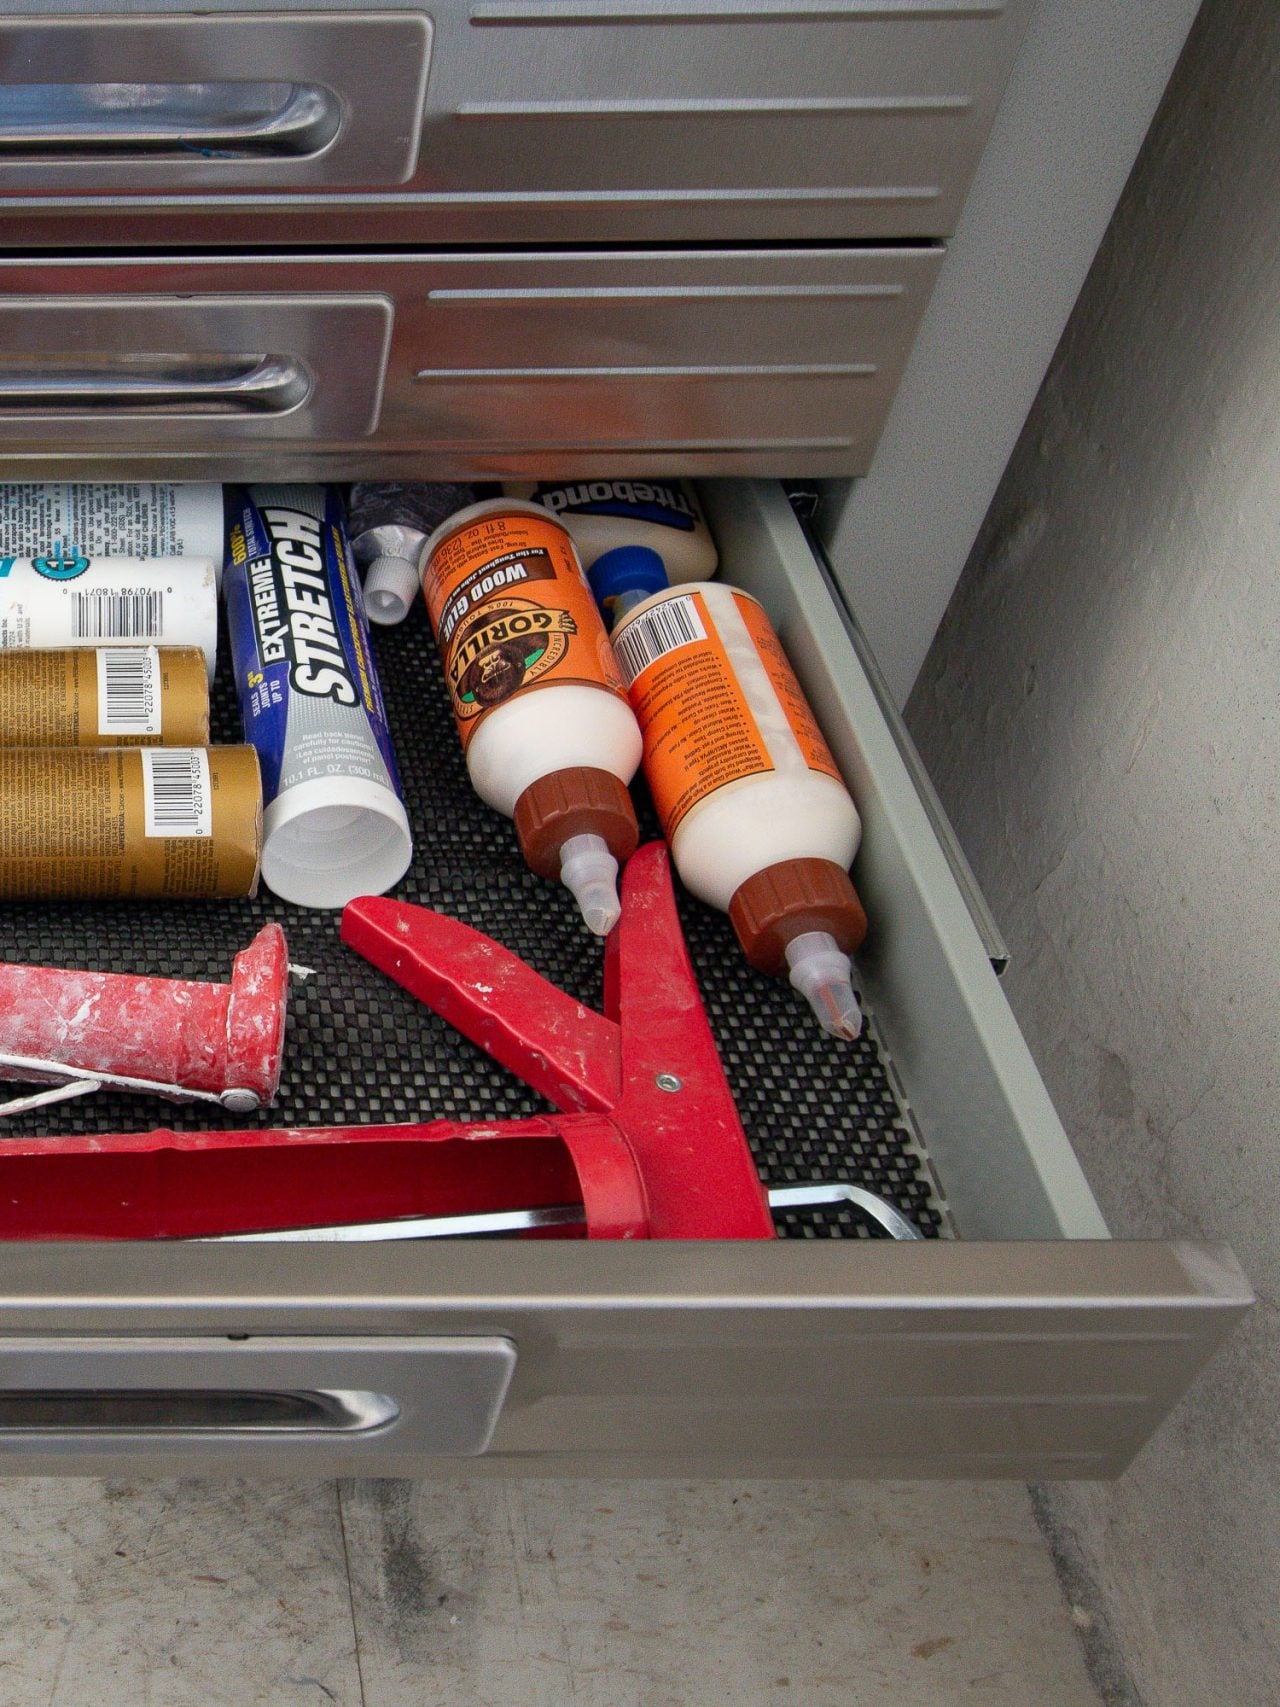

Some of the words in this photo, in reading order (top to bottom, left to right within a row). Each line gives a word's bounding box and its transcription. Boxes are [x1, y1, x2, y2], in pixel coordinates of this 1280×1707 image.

[541, 481, 697, 519] Titebond
[233, 524, 248, 565] 600%
[464, 528, 479, 539] oz.
[478, 553, 515, 575] Toughest
[516, 550, 529, 558] the
[84, 588, 114, 596] 18071
[121, 587, 151, 595] 70798
[470, 563, 527, 602] WOOD
[249, 558, 289, 663] EXTREME
[264, 509, 356, 704] STRETCH
[443, 596, 469, 642] GLUE
[488, 601, 513, 610] 100%
[450, 613, 552, 682] GORILLA
[529, 633, 562, 677] INCREDIBLY
[145, 683, 154, 713] 22078
[259, 682, 272, 708] JOINTS
[270, 680, 281, 691] TO
[272, 692, 283, 703] UP
[358, 670, 375, 713] PREMIUM
[250, 692, 261, 717] SEALS
[285, 771, 303, 786] 10.1
[308, 767, 324, 776] FL.
[327, 764, 345, 773] OZ.
[349, 765, 371, 777] (300
[193, 783, 203, 815] 22078
